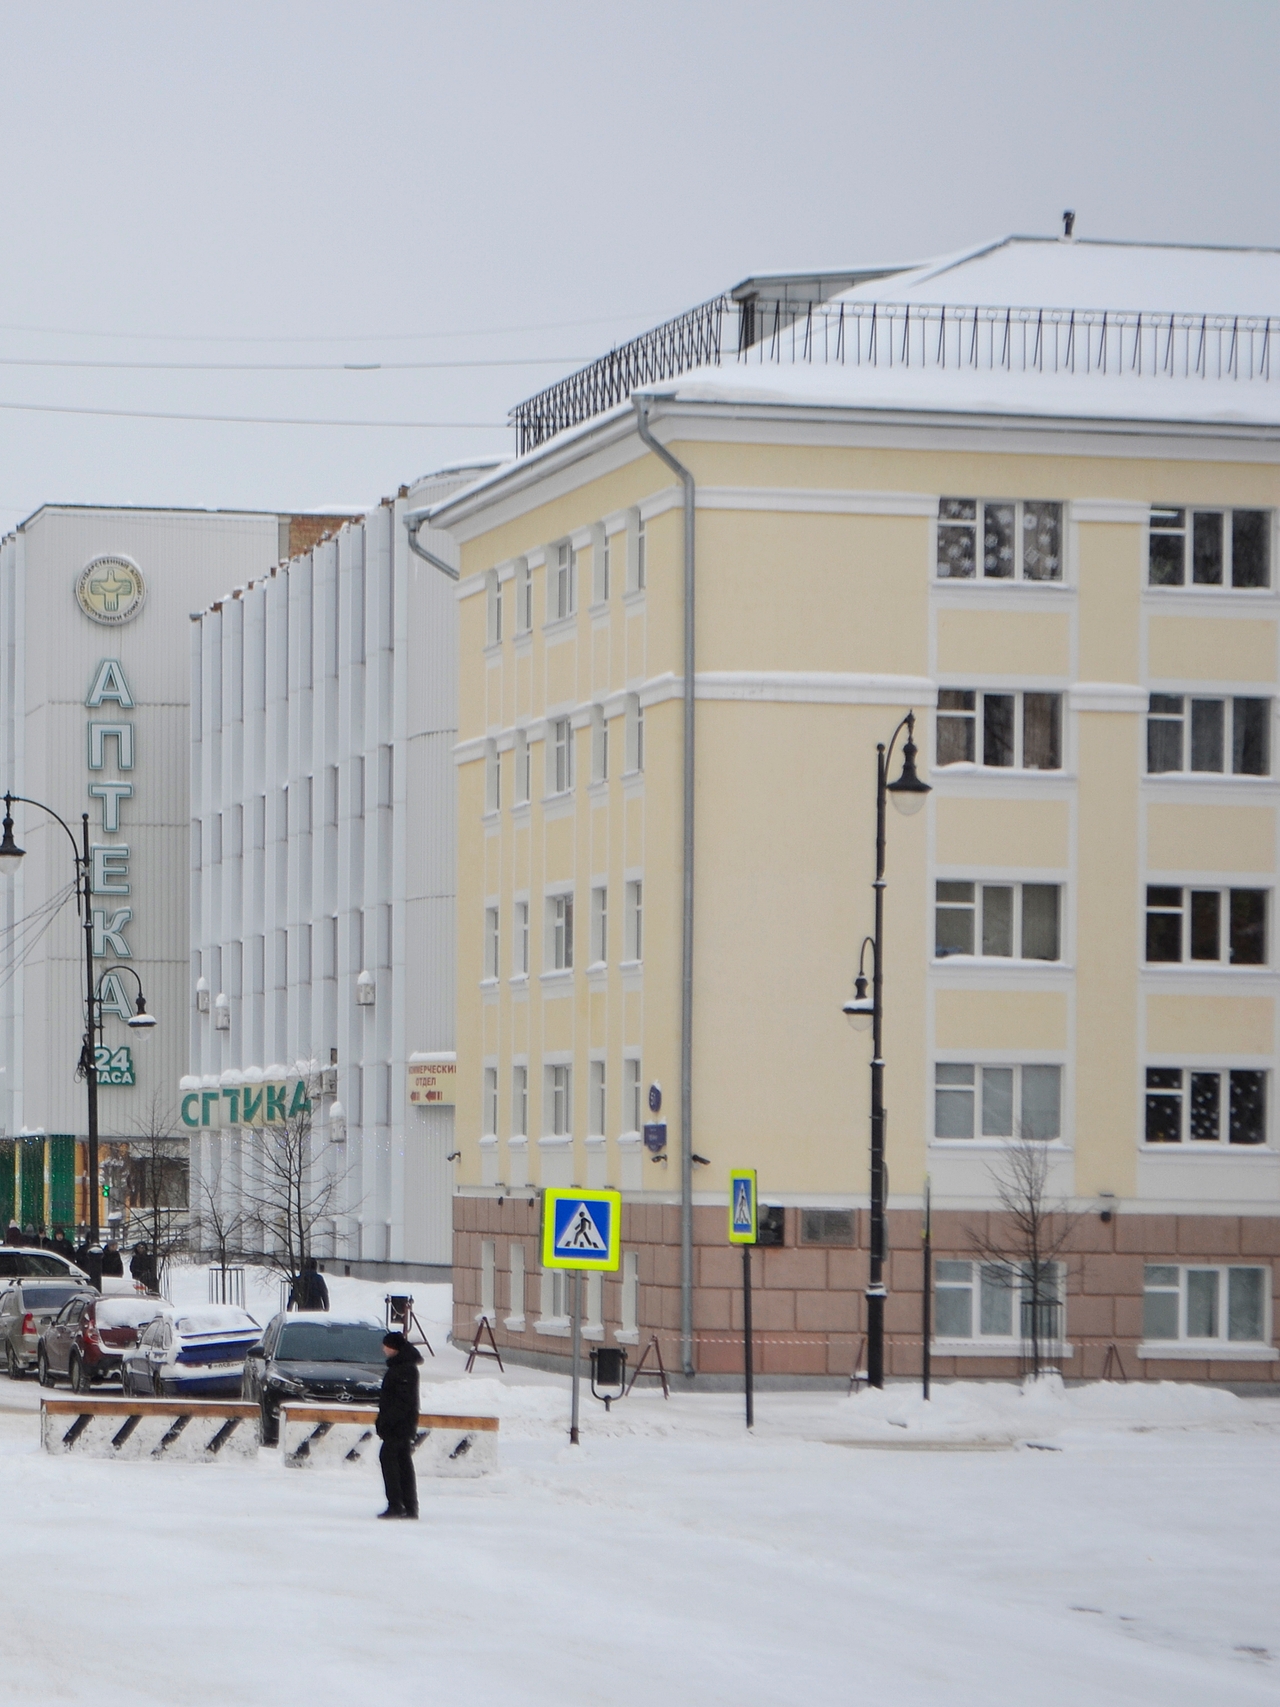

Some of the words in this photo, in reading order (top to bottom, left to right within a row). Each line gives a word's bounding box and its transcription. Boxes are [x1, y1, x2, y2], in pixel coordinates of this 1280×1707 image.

[86, 658, 135, 1022] АПТЕКА
[95, 1048, 130, 1072] 24
[415, 1077, 436, 1087] ОТДЕЛ
